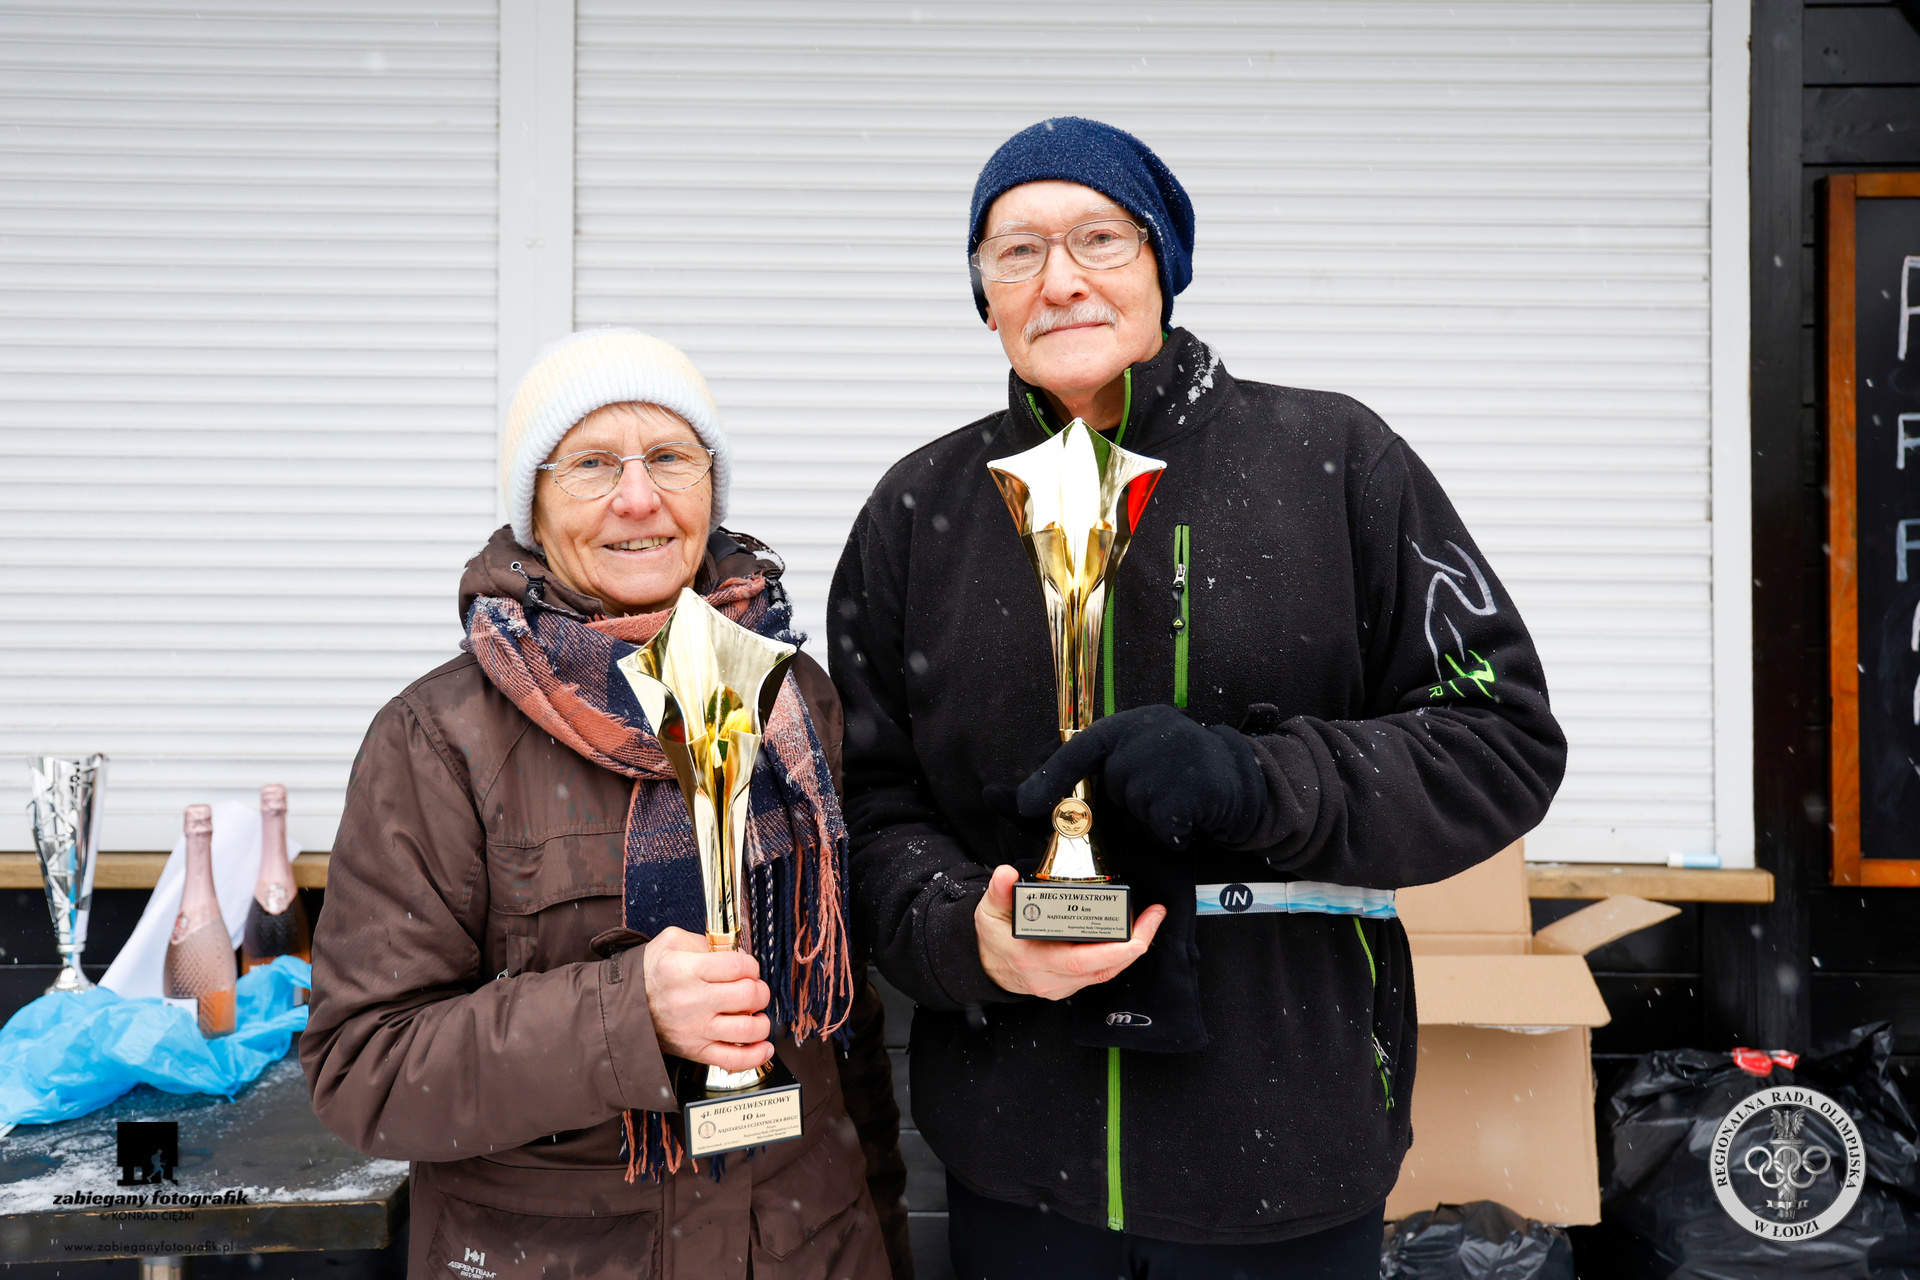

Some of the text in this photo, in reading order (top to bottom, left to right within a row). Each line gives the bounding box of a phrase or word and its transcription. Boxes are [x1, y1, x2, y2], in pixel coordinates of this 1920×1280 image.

[1039, 892, 1058, 900] BIEG
[1059, 893, 1118, 902] SYLWESTROWY
[1224, 890, 1248, 906] IN
[1067, 904, 1078, 912] 10
[714, 1107, 732, 1116] BIEG
[734, 1095, 791, 1111] SYLWESTROWY
